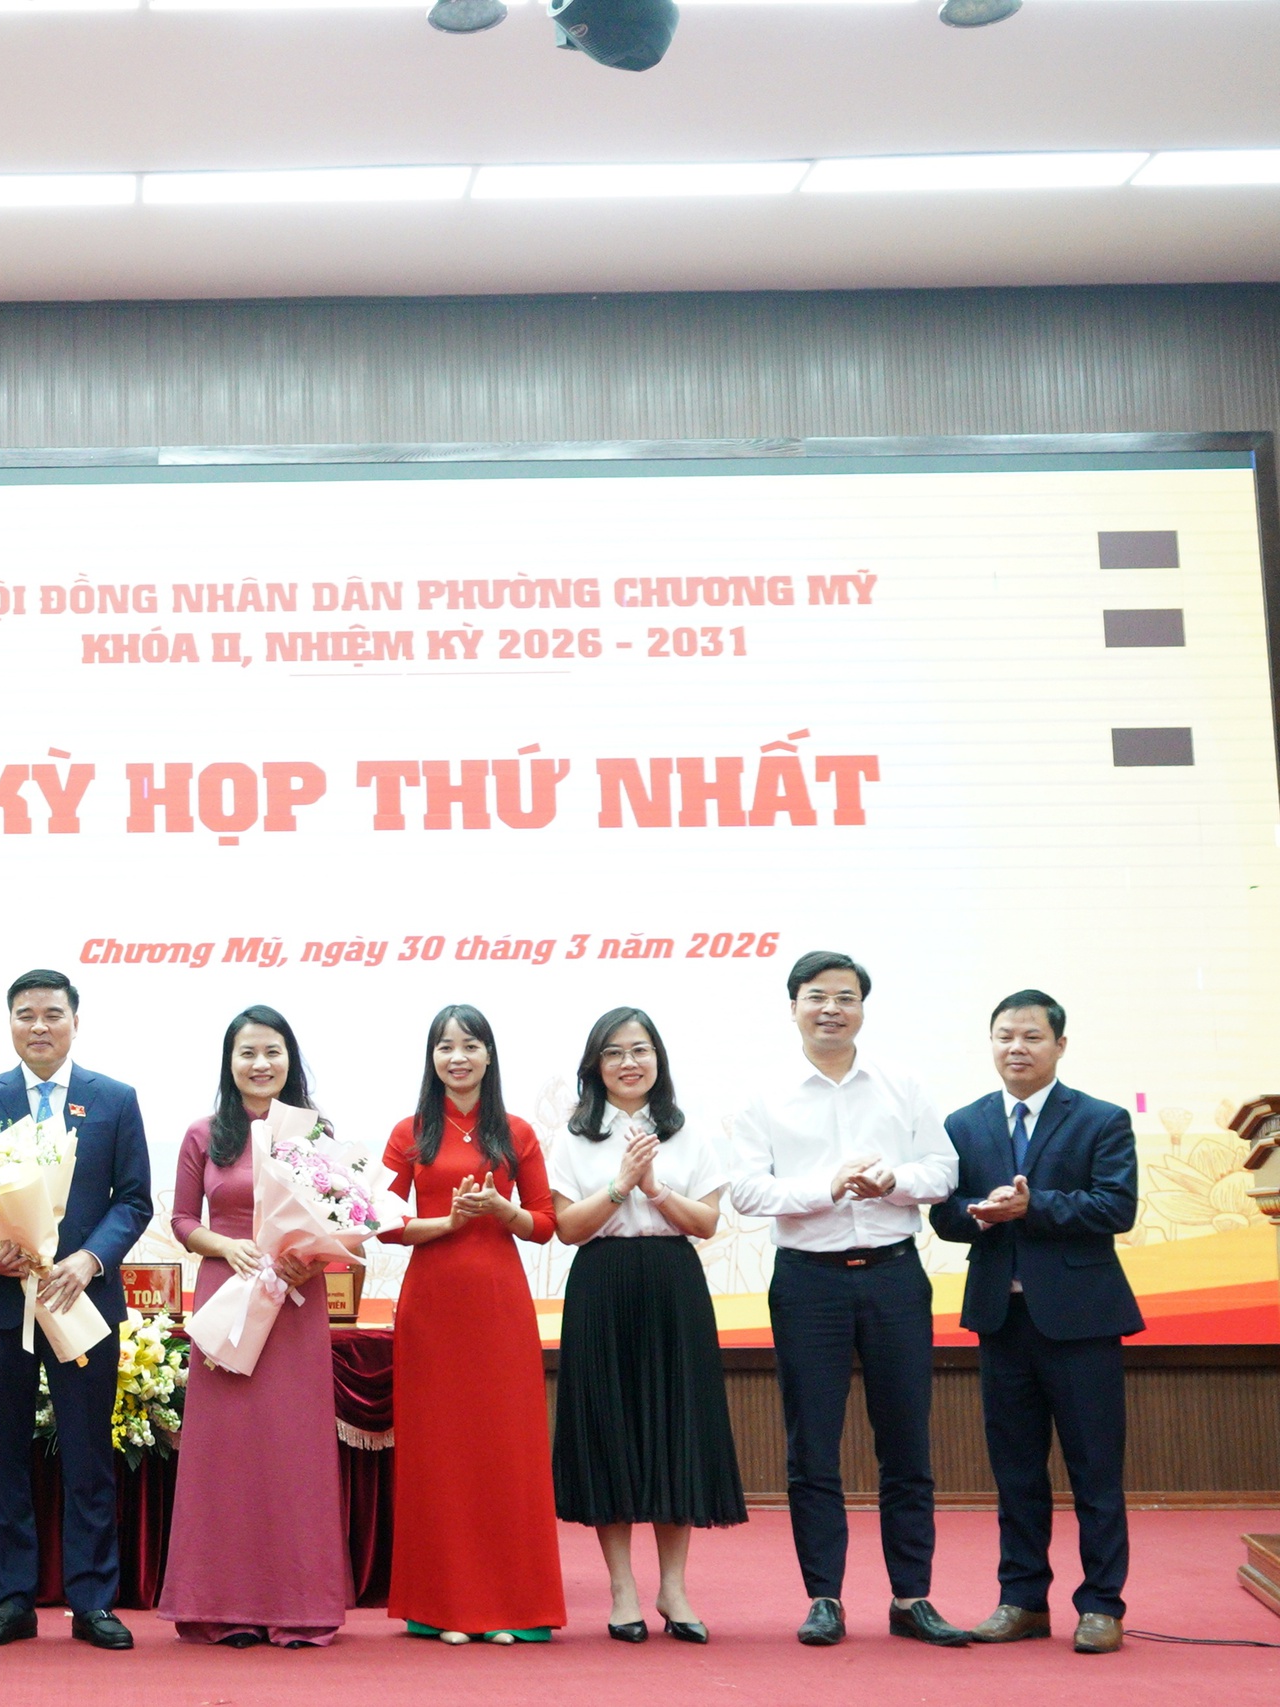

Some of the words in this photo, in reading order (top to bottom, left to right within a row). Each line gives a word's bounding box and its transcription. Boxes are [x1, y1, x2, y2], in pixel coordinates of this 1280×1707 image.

[40, 573, 158, 614] ĐỒNG
[172, 577, 298, 613] NHÂN
[312, 576, 403, 611] DÂN
[417, 572, 601, 610] PHƯỜNG
[614, 576, 795, 608] CHƯƠNG
[807, 569, 878, 605] MỸ
[81, 626, 200, 664] KHÓA
[211, 632, 252, 668] II,
[265, 624, 415, 667] NHIỆM
[427, 621, 484, 660] KỲ
[498, 628, 603, 659] 2026
[616, 641, 633, 649] -
[647, 626, 747, 657] 2031
[125, 761, 327, 847] HỌP
[356, 743, 571, 831] THỨ
[596, 728, 881, 829] NHẤT
[79, 938, 216, 969] Chương
[221, 936, 288, 968] Mỹ,
[300, 935, 389, 967] ngày
[397, 935, 447, 962] 30
[454, 934, 557, 965] tháng
[565, 934, 591, 960] 3
[597, 932, 675, 960] năm
[685, 932, 780, 959] 2026
[133, 1289, 163, 1308] TỌA
